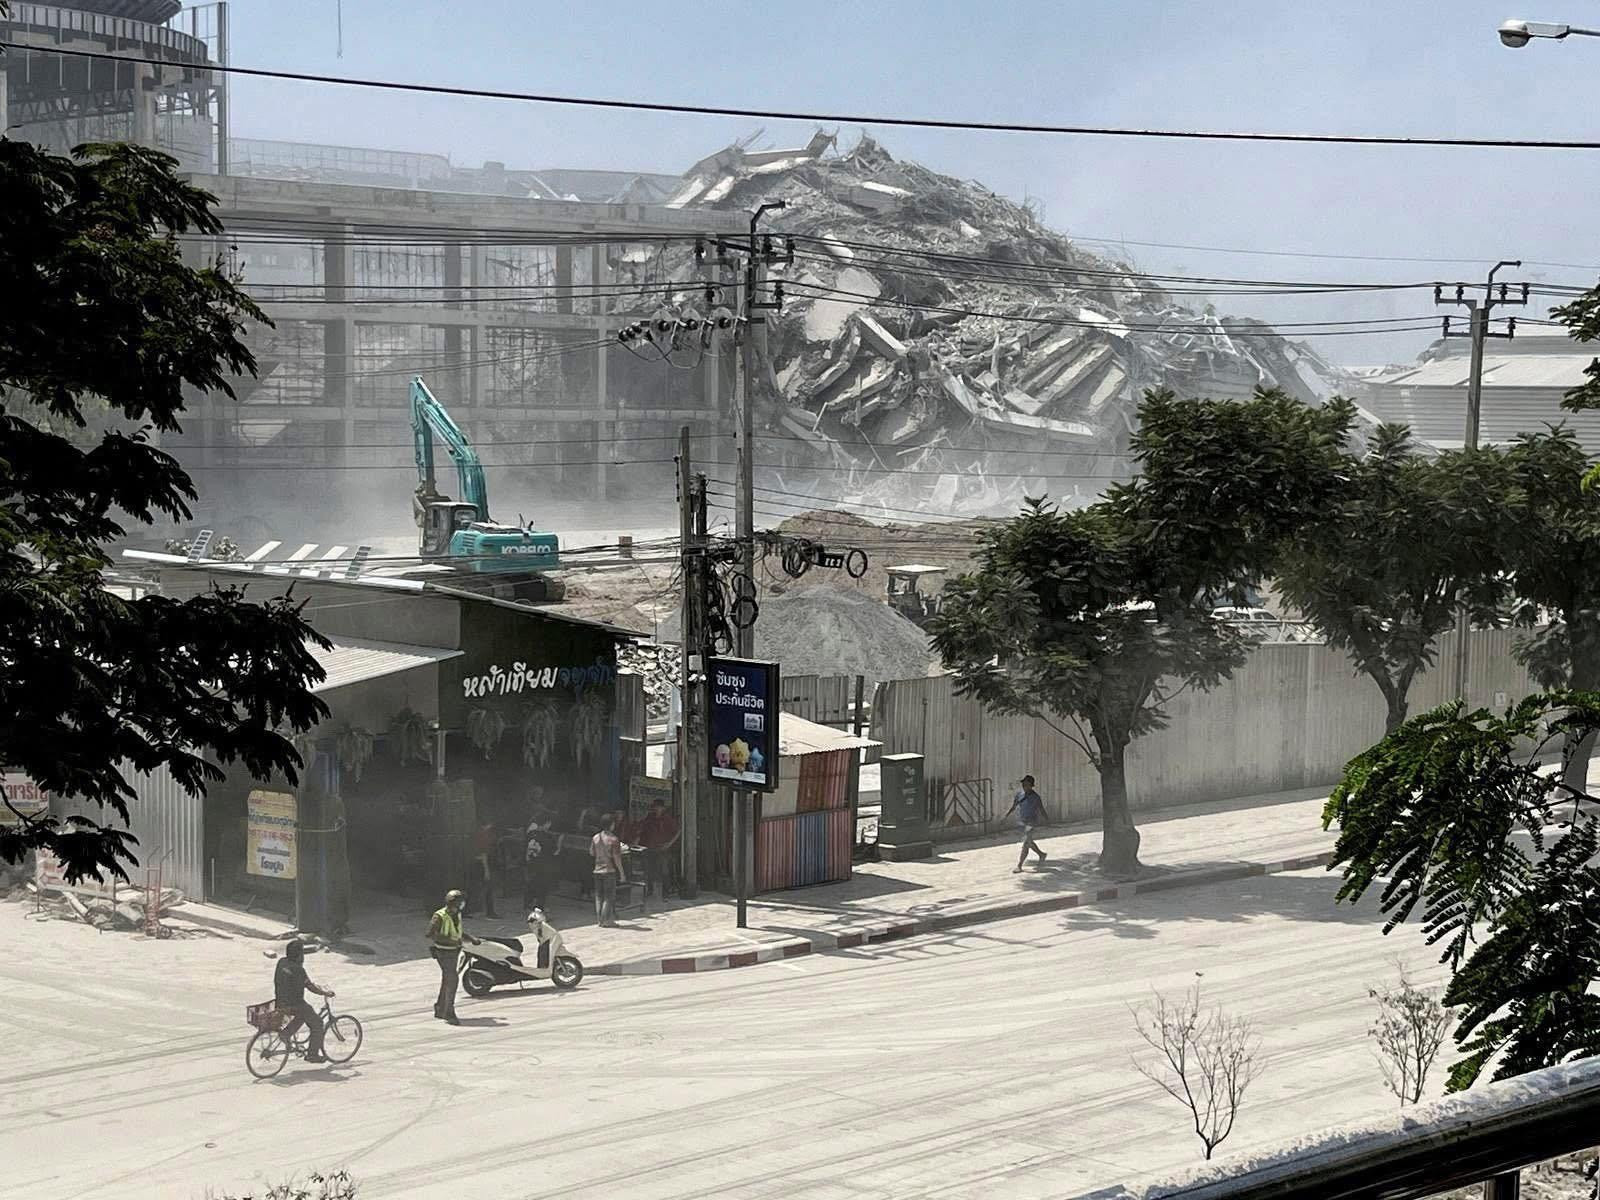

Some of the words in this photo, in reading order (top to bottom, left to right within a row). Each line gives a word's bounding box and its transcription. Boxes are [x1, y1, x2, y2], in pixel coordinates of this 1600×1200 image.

[715, 670, 746, 692] ซัมซุง
[715, 692, 765, 709] ประกันชีวิต
